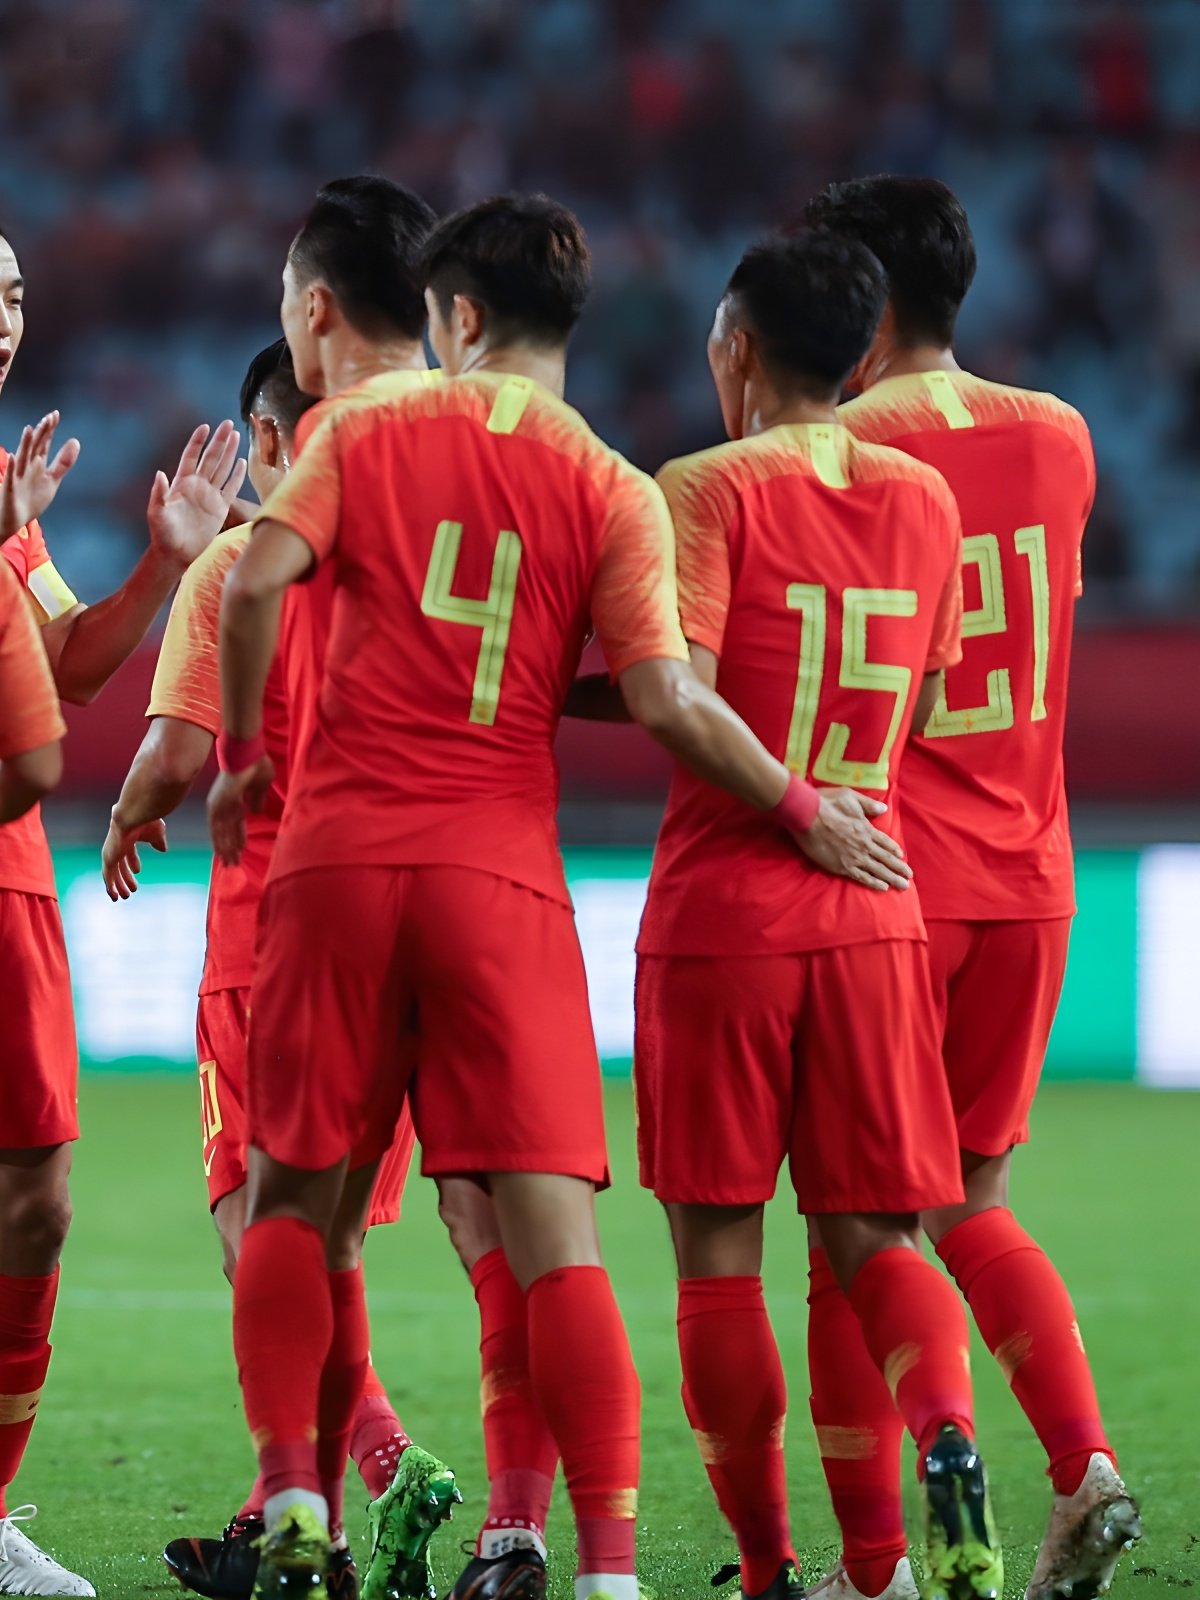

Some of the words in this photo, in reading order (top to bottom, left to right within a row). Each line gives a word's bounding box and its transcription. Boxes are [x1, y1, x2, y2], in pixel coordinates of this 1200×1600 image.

[420, 519, 522, 726] 4
[784, 582, 918, 791] 15
[923, 524, 1050, 738] 21
